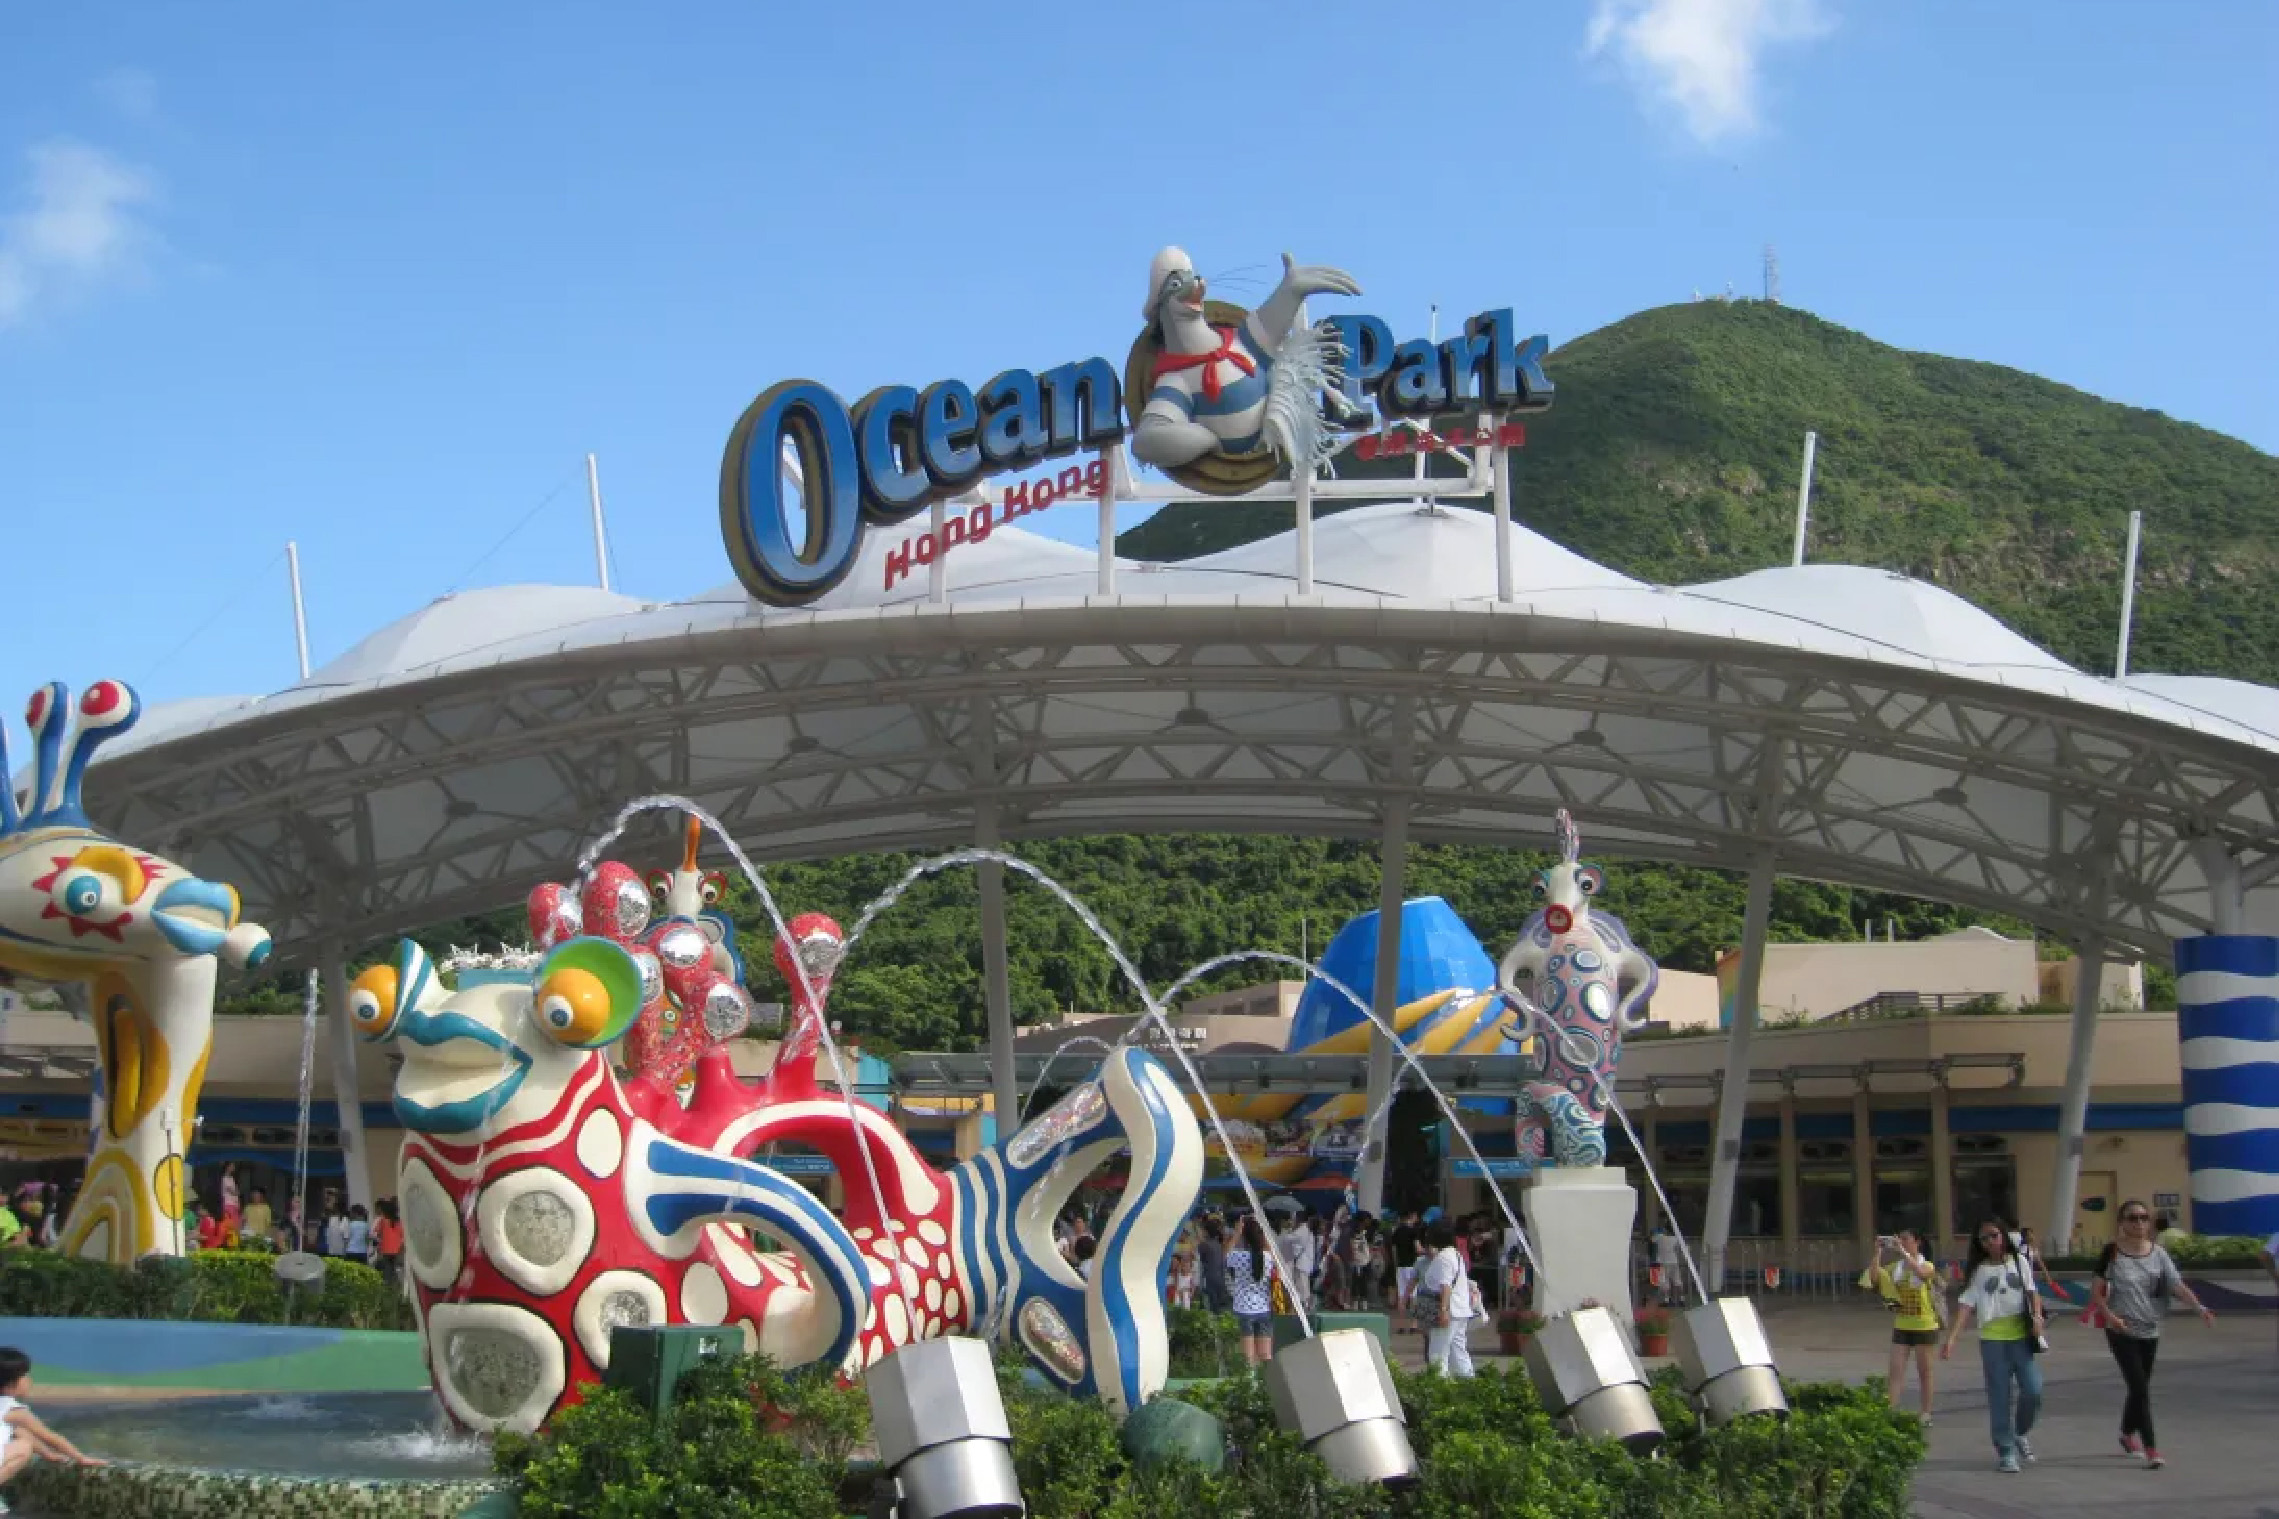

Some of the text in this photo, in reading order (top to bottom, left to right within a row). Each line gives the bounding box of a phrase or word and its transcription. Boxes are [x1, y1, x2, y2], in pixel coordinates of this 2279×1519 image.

[720, 307, 1554, 607] Ocean Park
[884, 459, 1109, 591] Hong Kong
